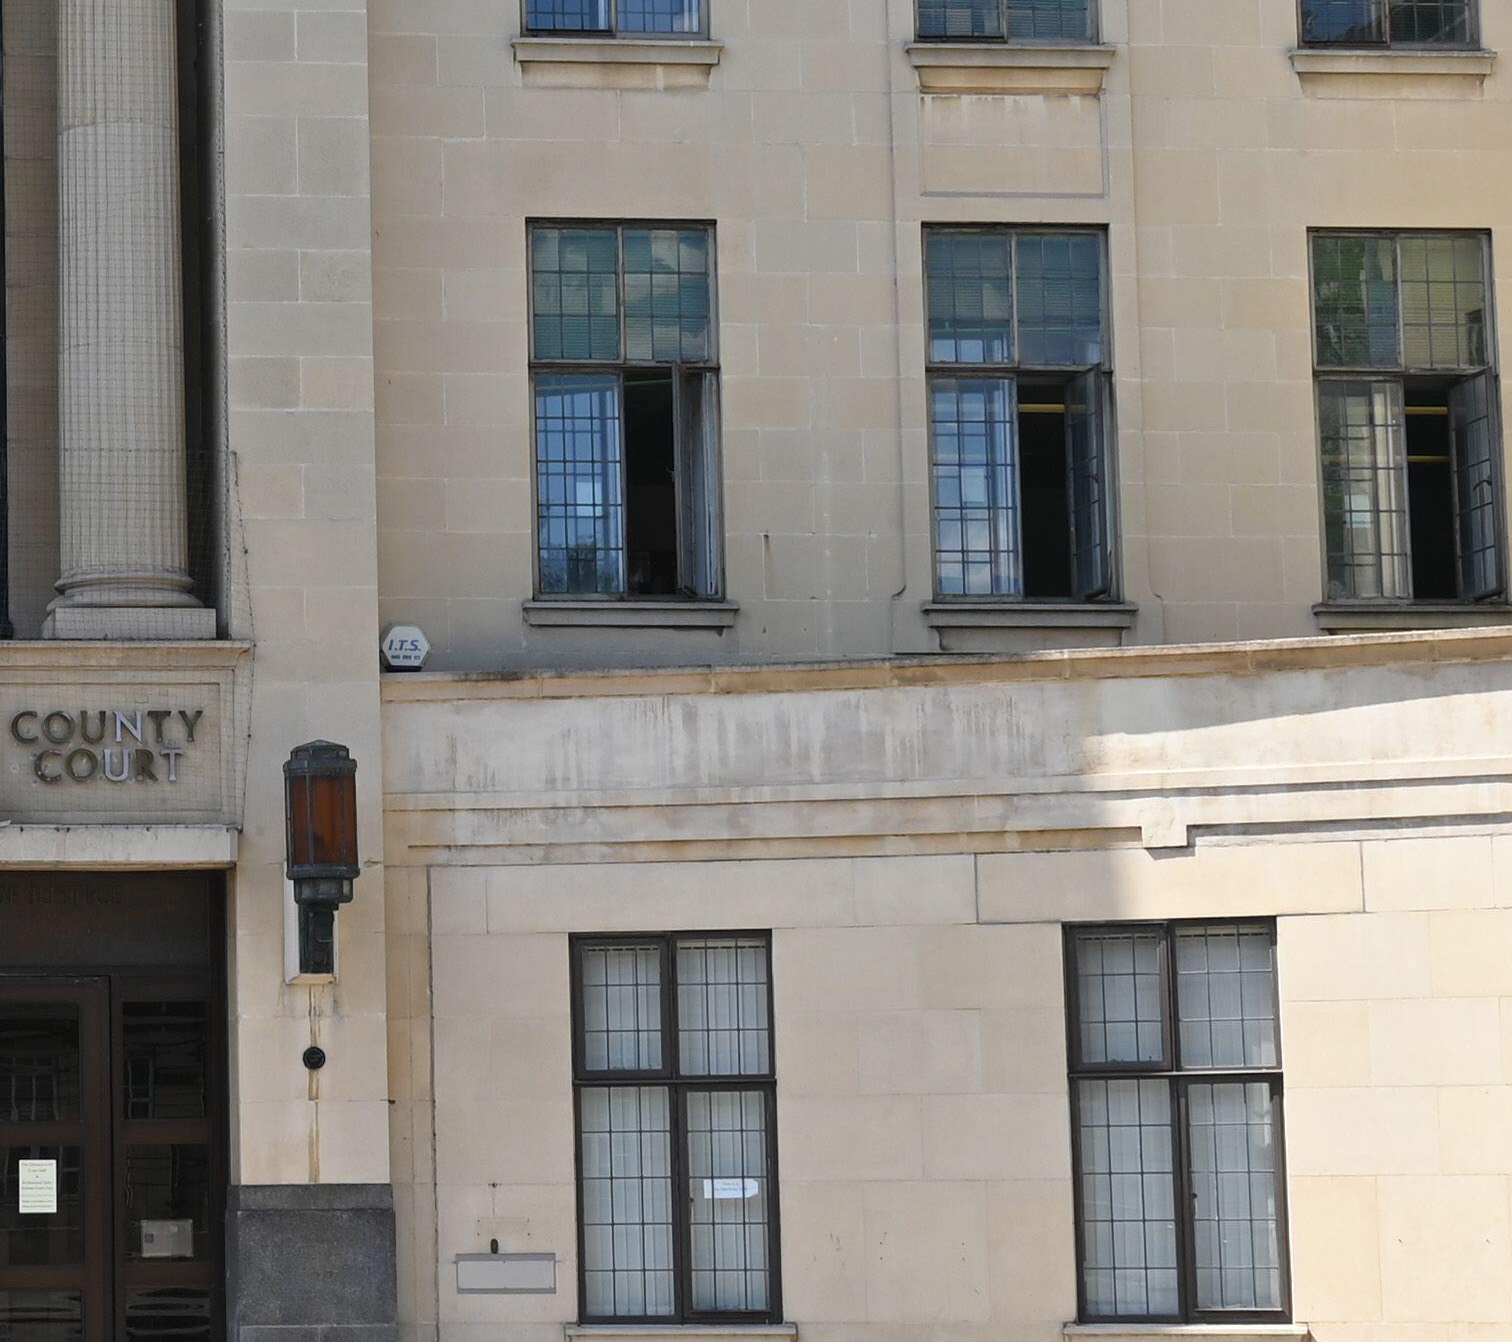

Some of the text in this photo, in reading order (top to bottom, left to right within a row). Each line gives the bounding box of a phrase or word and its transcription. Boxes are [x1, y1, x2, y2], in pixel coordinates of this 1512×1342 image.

[388, 639, 422, 651] I.T.S.
[10, 710, 204, 745] COUNTY
[34, 748, 184, 783] COURT
[27, 884, 123, 906] JUSTICE
